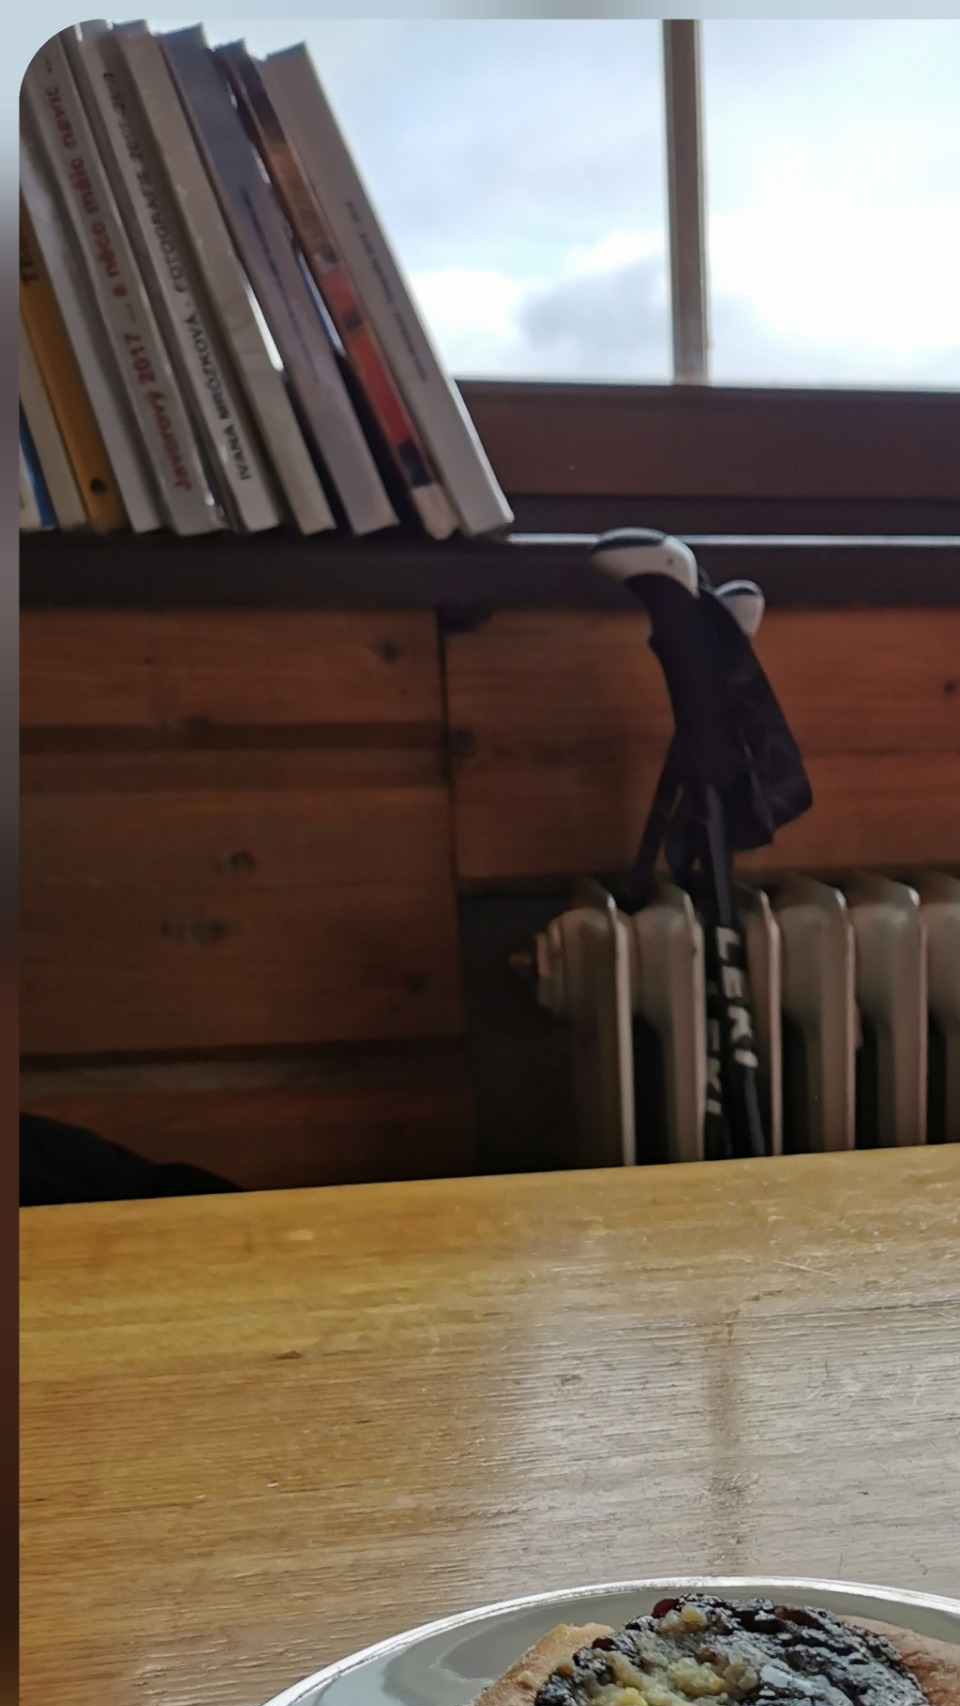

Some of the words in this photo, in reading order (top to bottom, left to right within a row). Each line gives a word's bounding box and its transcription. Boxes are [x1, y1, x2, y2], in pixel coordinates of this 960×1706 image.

[69, 158, 98, 213] málo
[91, 220, 119, 277] něco
[113, 285, 127, 297] a
[124, 332, 155, 385] 2017
[148, 391, 192, 491] Javorový
[224, 424, 251, 480] IVANA
[716, 926, 758, 1069] LEKI
